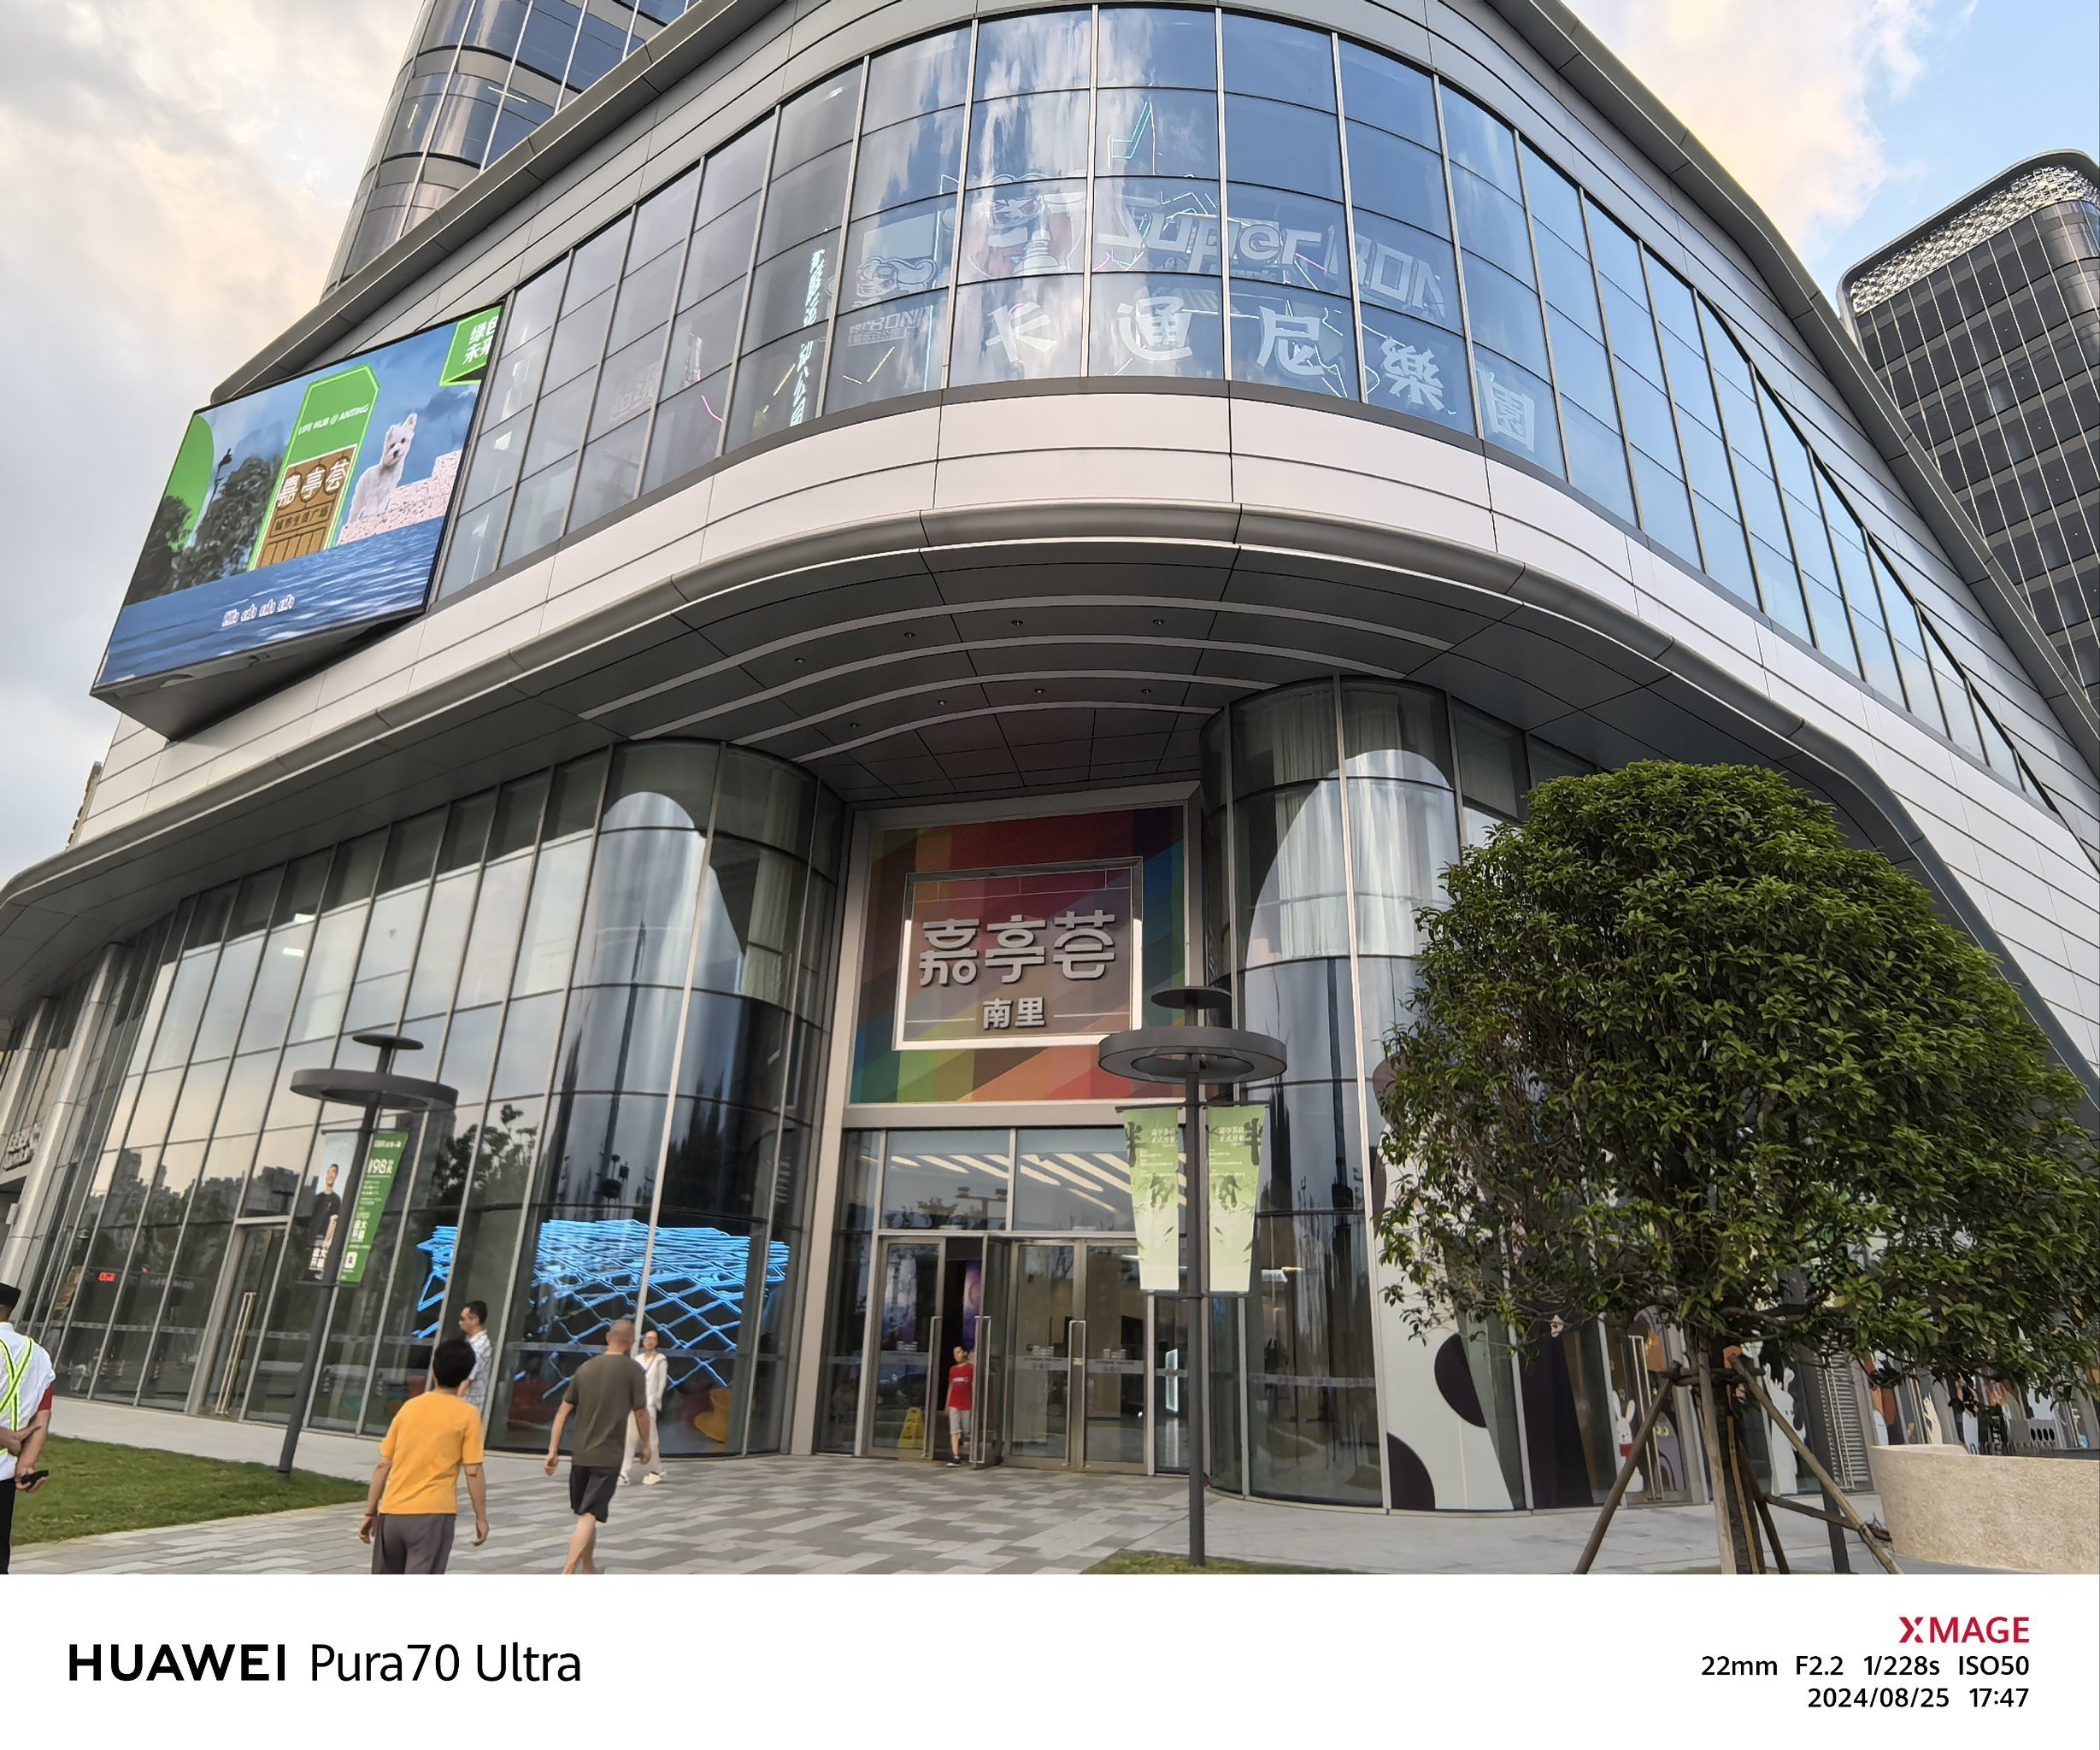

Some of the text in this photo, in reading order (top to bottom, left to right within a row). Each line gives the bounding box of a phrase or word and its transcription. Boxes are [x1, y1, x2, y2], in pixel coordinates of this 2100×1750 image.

[275, 458, 350, 507] 嘉亭荟
[919, 909, 1115, 987] 嘉亭荟
[982, 996, 1045, 1029] 南里
